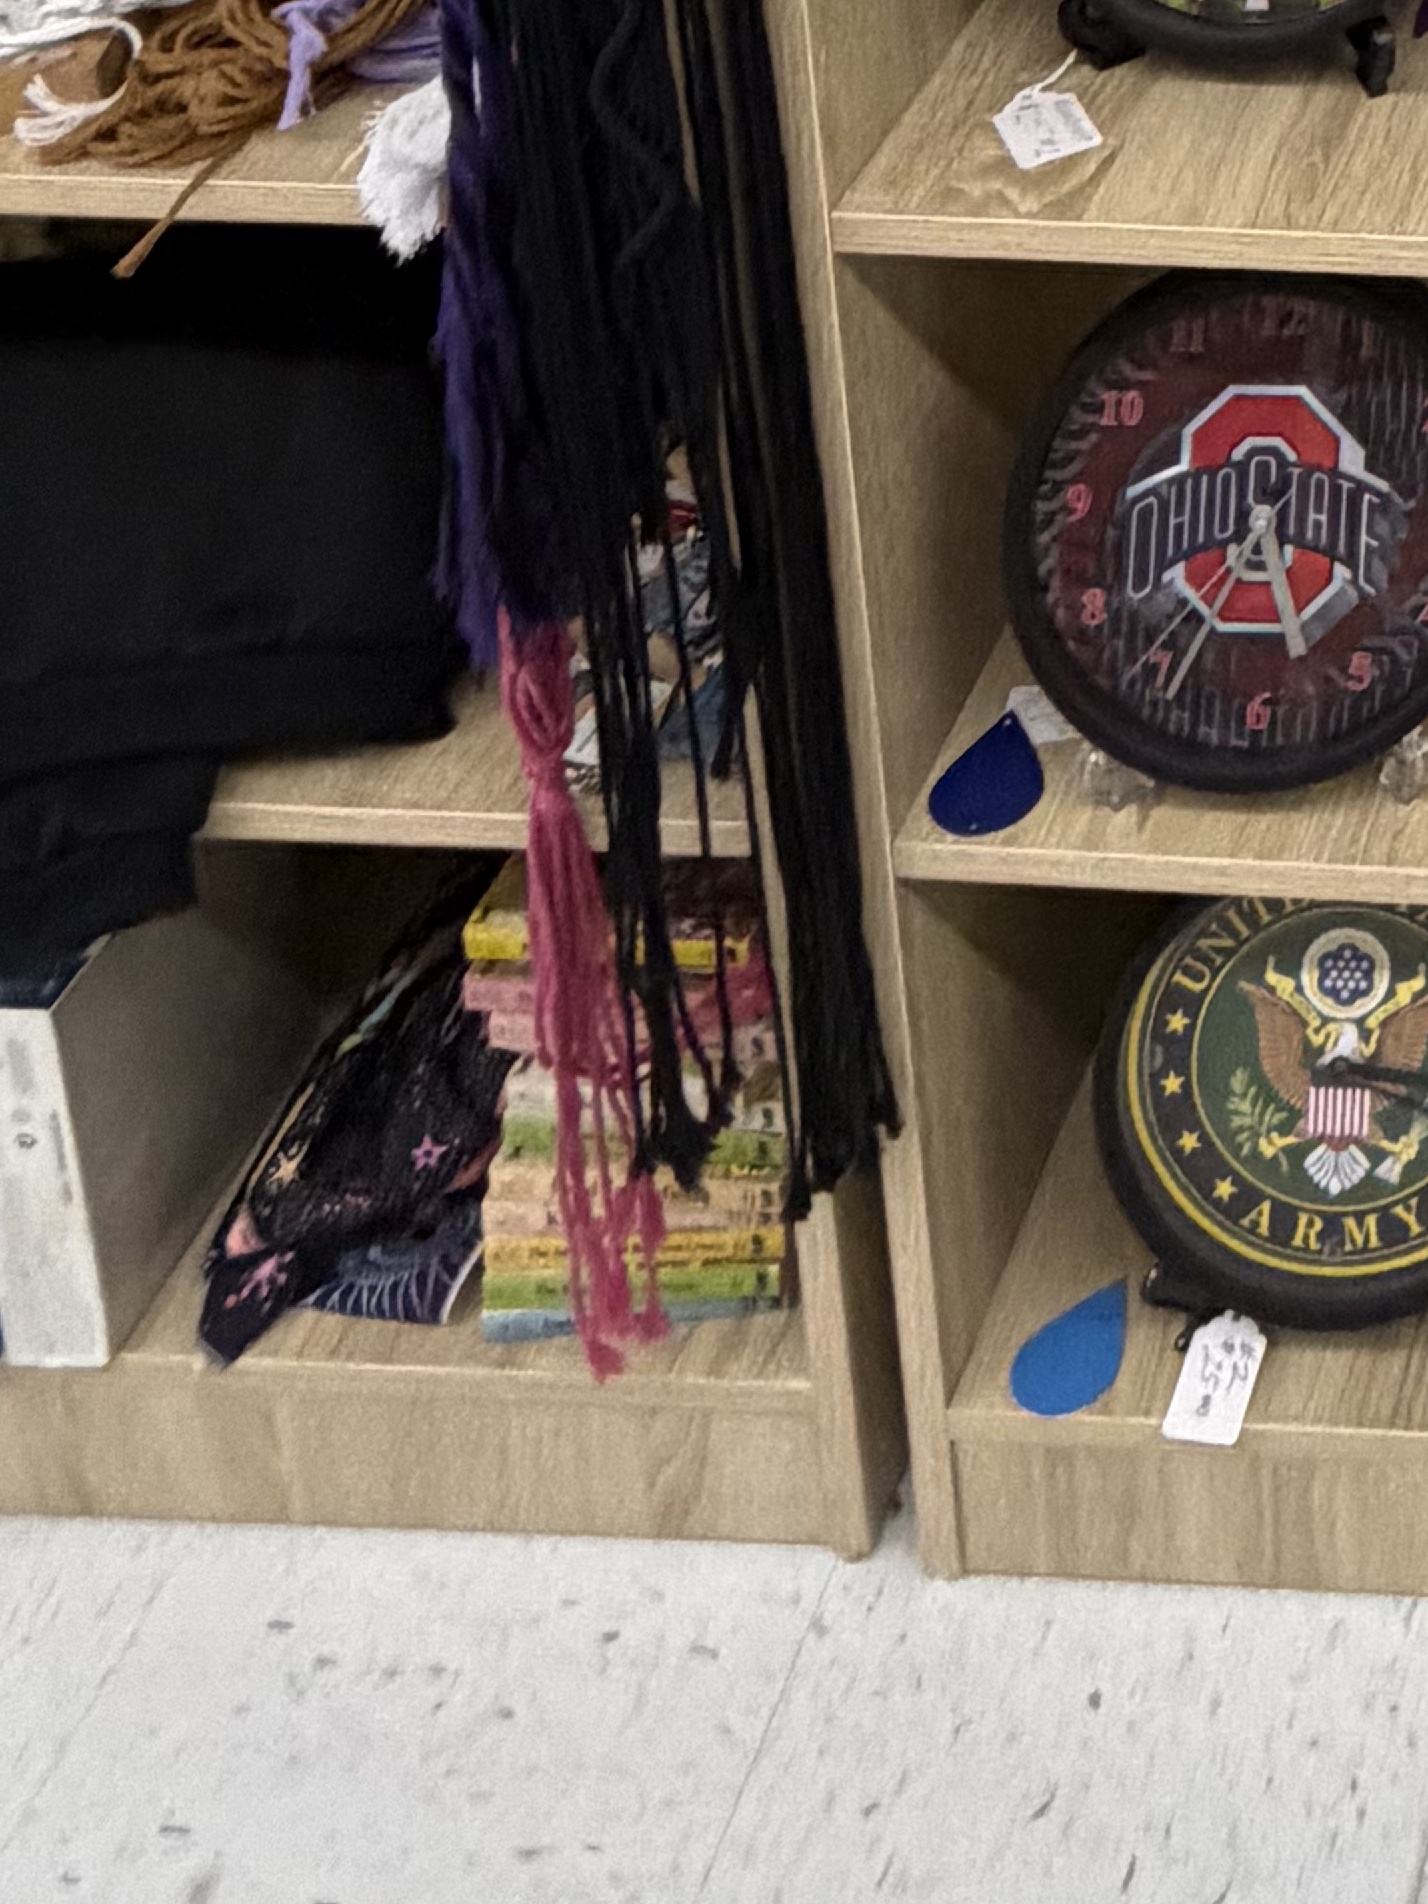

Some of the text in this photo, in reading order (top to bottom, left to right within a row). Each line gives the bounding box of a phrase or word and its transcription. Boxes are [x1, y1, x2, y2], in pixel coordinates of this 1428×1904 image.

[1101, 392, 1144, 425] 10
[1127, 455, 1381, 601] OHIO STATE
[1239, 1200, 1421, 1253] ARMY
